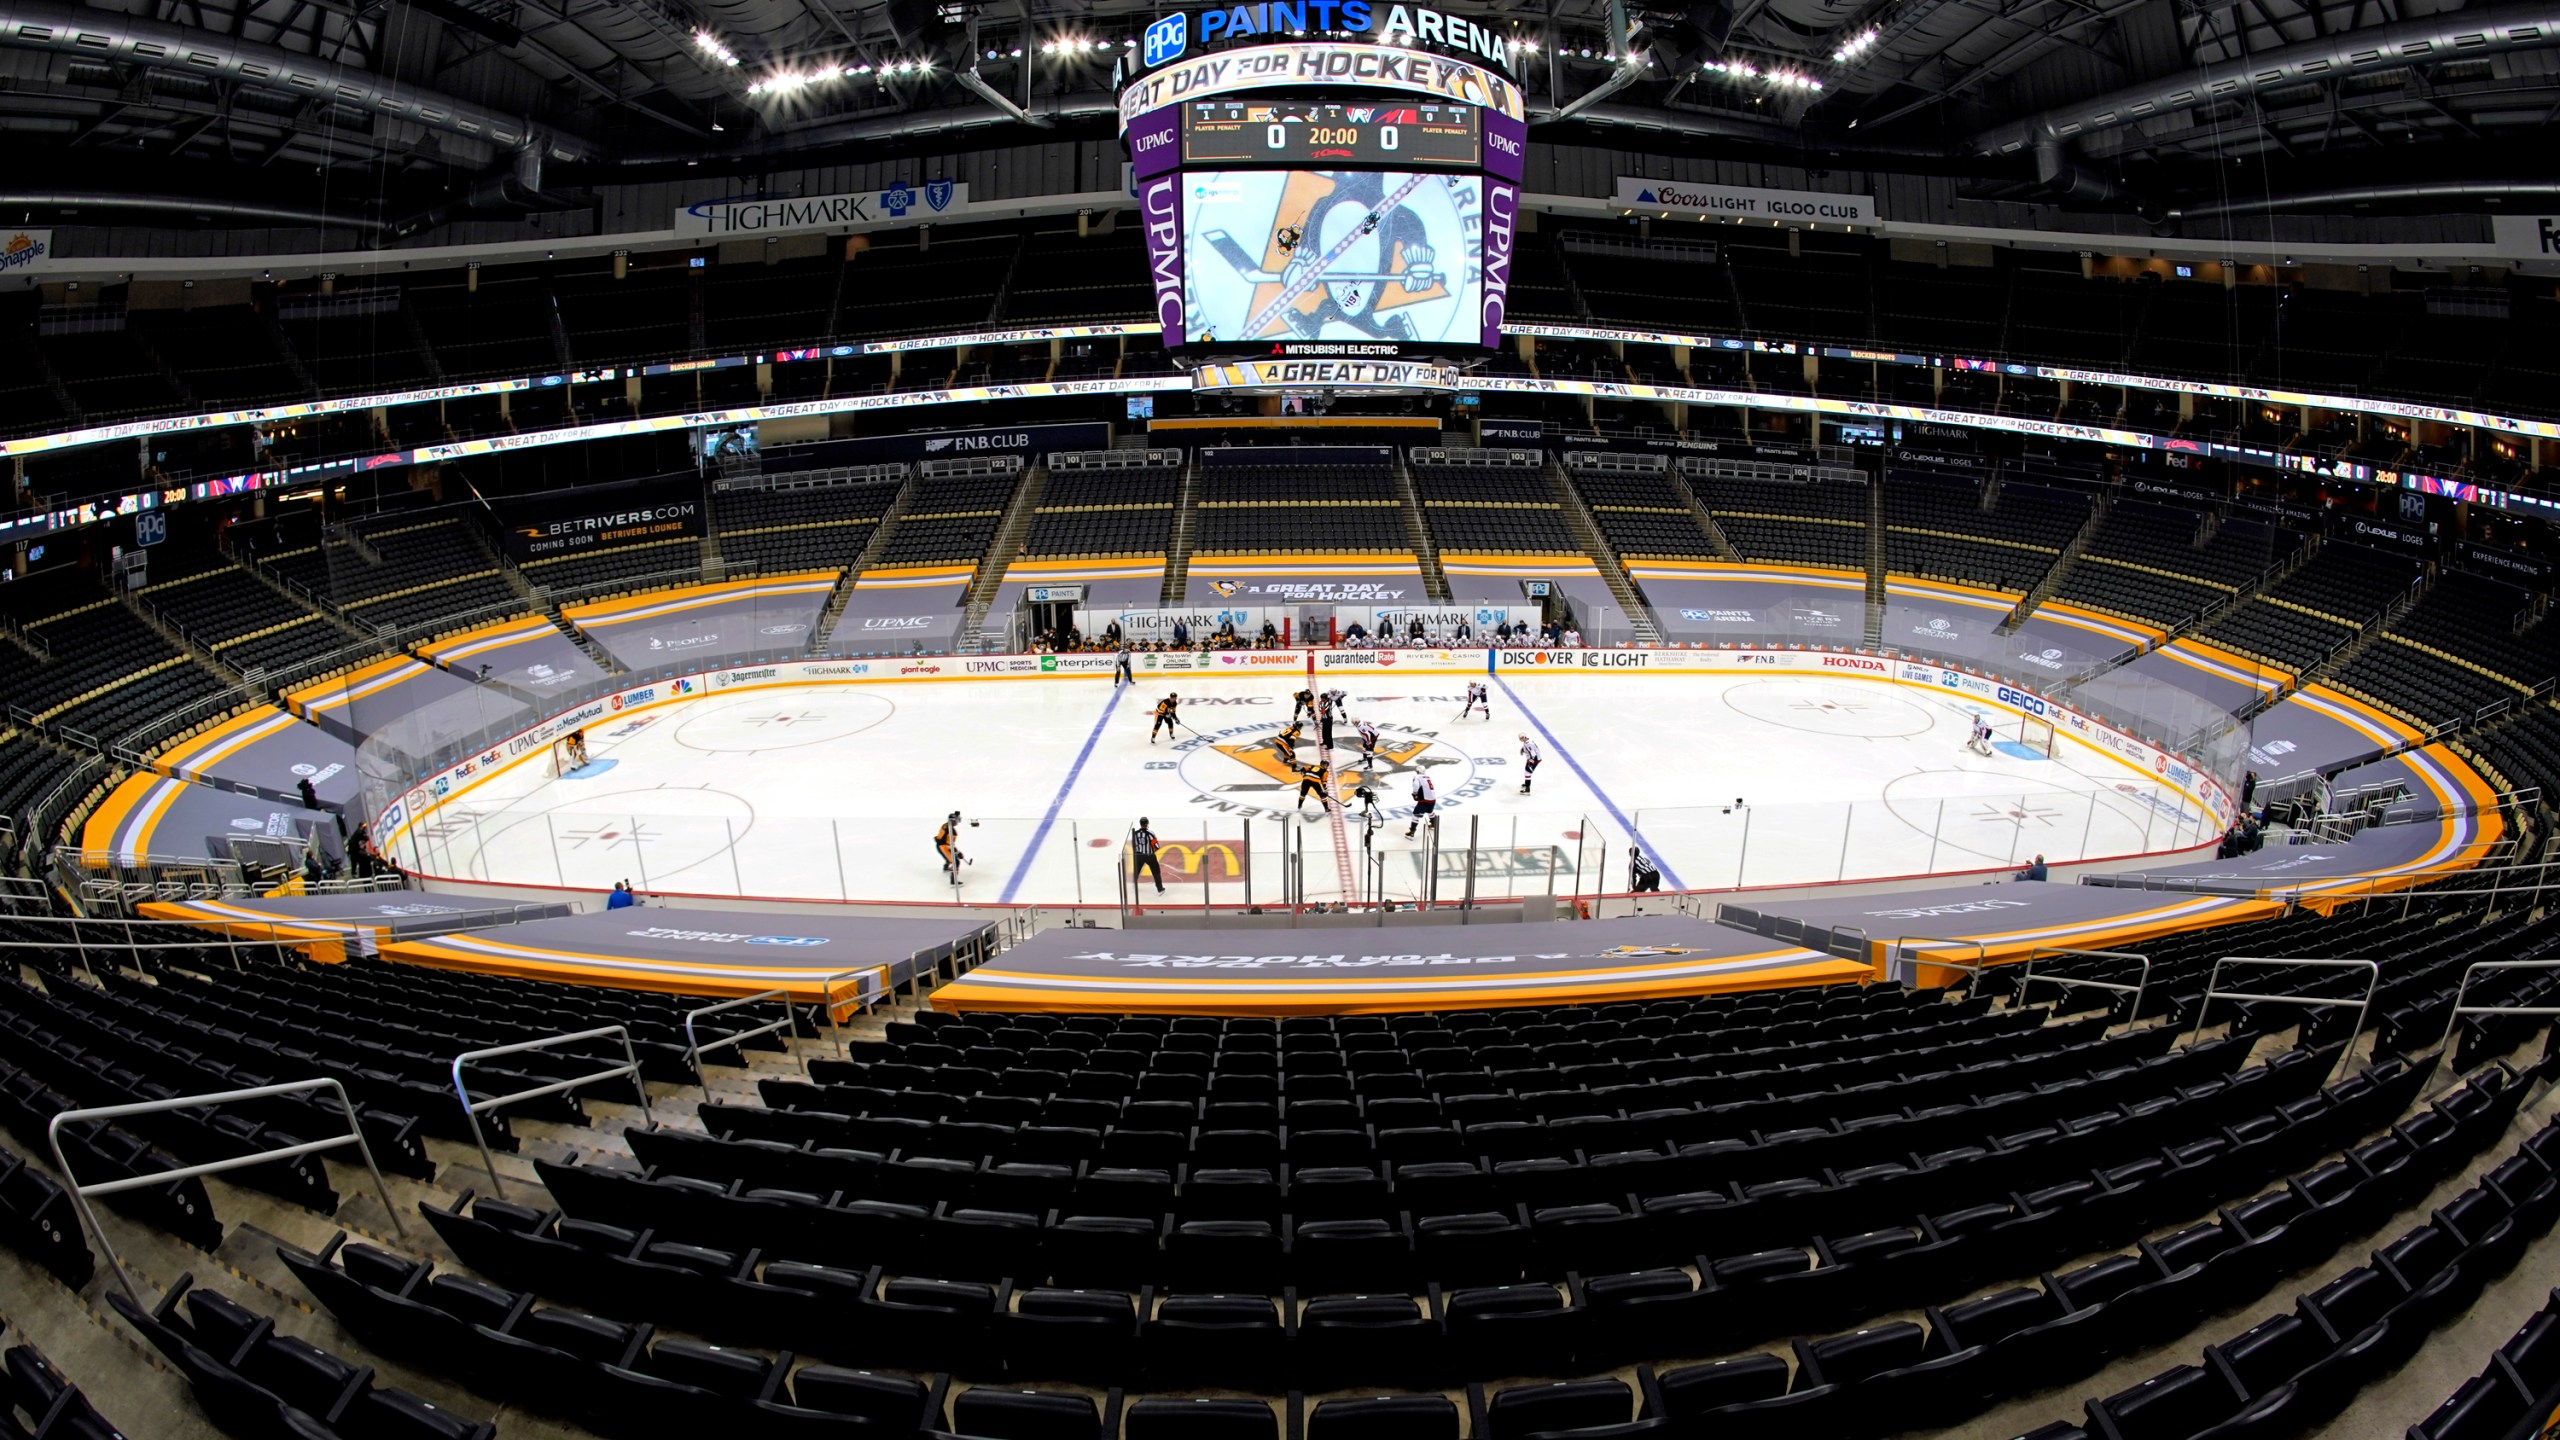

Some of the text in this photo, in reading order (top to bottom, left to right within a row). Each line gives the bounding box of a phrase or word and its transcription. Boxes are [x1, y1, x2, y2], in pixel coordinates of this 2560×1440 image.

[1147, 0, 1509, 69] PPG PAINTS ARENA
[1171, 50, 1453, 97] DAY FOR HOCKEY
[1203, 110, 1210, 120] 1
[1230, 110, 1238, 120] 0
[1136, 128, 1174, 153] UPMC
[1267, 124, 1286, 149] 0
[1309, 127, 1358, 145] 20:00
[1380, 126, 1399, 150] 0
[1488, 131, 1520, 157] UPMC
[1658, 186, 1859, 219] Coors LIGHT IGLOO CLUB
[707, 196, 869, 233] HIGHMARK
[1147, 177, 1184, 329] UPMC
[1482, 186, 1514, 330] UPMC
[898, 331, 1028, 350] GREAT HOCKEY
[1509, 326, 1638, 340] GREAT HOCKEY
[1285, 345, 1399, 355] MITSUBISHI ELECTRIC
[1850, 351, 1896, 361] BLOCKED SHOTS
[669, 360, 716, 371] BLOCKED SHOTS
[1282, 363, 1413, 383] GREAT DAY
[1461, 379, 1513, 389] HOCKEY
[2069, 371, 2188, 391] GREAT HOCKEY
[339, 388, 458, 409] GREAT HOCKEY
[778, 396, 908, 415] GREAT HOCKEY
[2398, 405, 2441, 419] HOCKEY
[152, 417, 196, 432] HOCKEY
[1938, 412, 2064, 435] GREAT HOCKEY
[1498, 429, 1541, 439] F.N.B. CLUB
[1914, 425, 1969, 440] HIGHMARK
[955, 434, 1029, 451] F.N.B. CLUB
[1677, 441, 1719, 450] PENGUINS
[991, 460, 1005, 468] 122
[1066, 455, 1080, 464] 101
[1149, 452, 1162, 461] 101
[1511, 452, 1525, 461] 103
[1583, 455, 1597, 463] 104
[1912, 454, 1972, 466] LEXUS LOGES
[2165, 452, 2202, 470] FedEx
[1794, 468, 1808, 476] 104
[2356, 467, 2363, 479] 0
[2376, 470, 2397, 484] 20:00
[717, 482, 730, 490] 121
[2409, 474, 2416, 489] 0
[143, 493, 151, 508] 0
[164, 488, 187, 503] 20:00
[254, 489, 267, 499] 119
[2183, 491, 2203, 500] LOGES
[2285, 509, 2311, 520] AMAZING
[2401, 497, 2424, 518] PPG
[550, 504, 695, 536] BETRIVERS.COM
[138, 515, 164, 542] PPG
[2366, 526, 2424, 546] LEXUS LOGES
[530, 522, 683, 552] COMING SOON BETRIVERS LOUNGE
[15, 540, 29, 552] 117
[2472, 551, 2538, 575] EXPERIENCE AMAZING
[1035, 588, 1075, 599] PPG PAINTS
[1265, 583, 1337, 593] GREAT
[1343, 583, 1386, 592] DAY
[1283, 591, 1316, 599] FOR
[1532, 584, 1546, 595] PPG
[864, 616, 934, 628] UPMC
[1129, 614, 1213, 629] HIGHMARK
[1386, 611, 1470, 627] HIGHMARK
[1041, 656, 1114, 669] enterprise
[1250, 655, 1298, 664] DUNKIN'
[1324, 651, 1396, 667] guaranteed Rate
[1503, 651, 1574, 665] DISCOVER
[1582, 652, 1649, 667] IC LIGHT
[1822, 656, 1887, 672] HONDA
[2019, 652, 2063, 670] LUMBER
[808, 666, 852, 676] HIGHMARK
[900, 664, 941, 675] giant eagle
[966, 660, 1006, 673] UPMC
[1902, 670, 1933, 683] LIVE GAMES
[1942, 671, 1991, 693] PPG PAINTS
[612, 696, 623, 710] 84
[624, 689, 655, 706] LUMBER
[1997, 687, 2045, 716] GEICO
[563, 704, 603, 728] MassMutual
[2048, 705, 2066, 722] FedEx
[2070, 715, 2090, 733] FedEx
[509, 730, 541, 756] UPMC
[2095, 728, 2124, 751] UPMC
[2125, 749, 2145, 762] MEDICINE
[2126, 742, 2143, 754] SPORTS
[481, 750, 502, 766] FedEx
[455, 763, 478, 780] FedEx
[2156, 757, 2167, 771] 84
[2167, 763, 2193, 785] LUMBER
